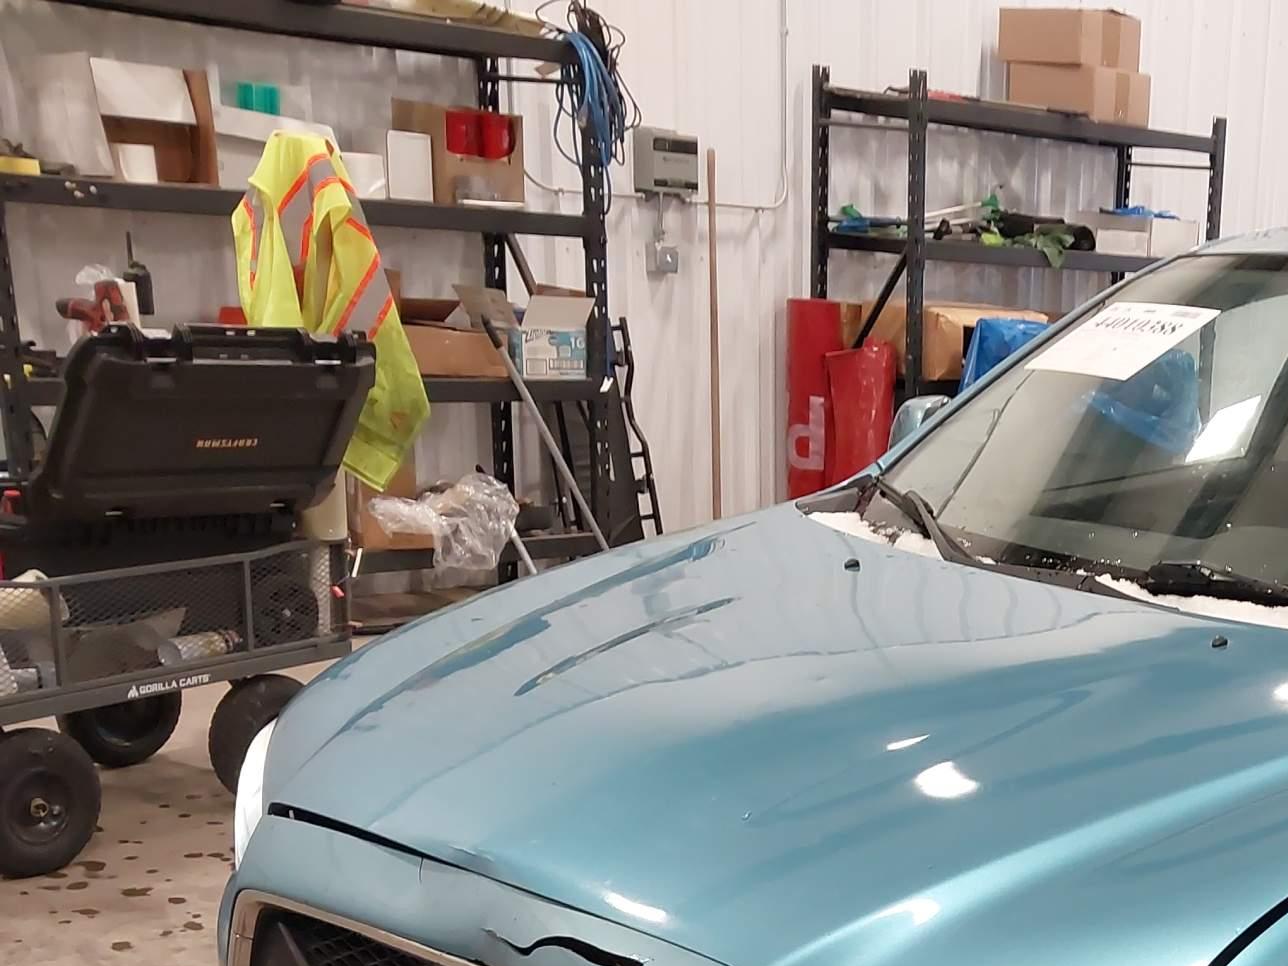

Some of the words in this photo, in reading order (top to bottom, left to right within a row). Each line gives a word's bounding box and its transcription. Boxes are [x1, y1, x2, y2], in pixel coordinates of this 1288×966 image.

[195, 438, 259, 448] CRAFTSMAN
[139, 680, 178, 695] GORILLA
[179, 673, 209, 688] CARTS
